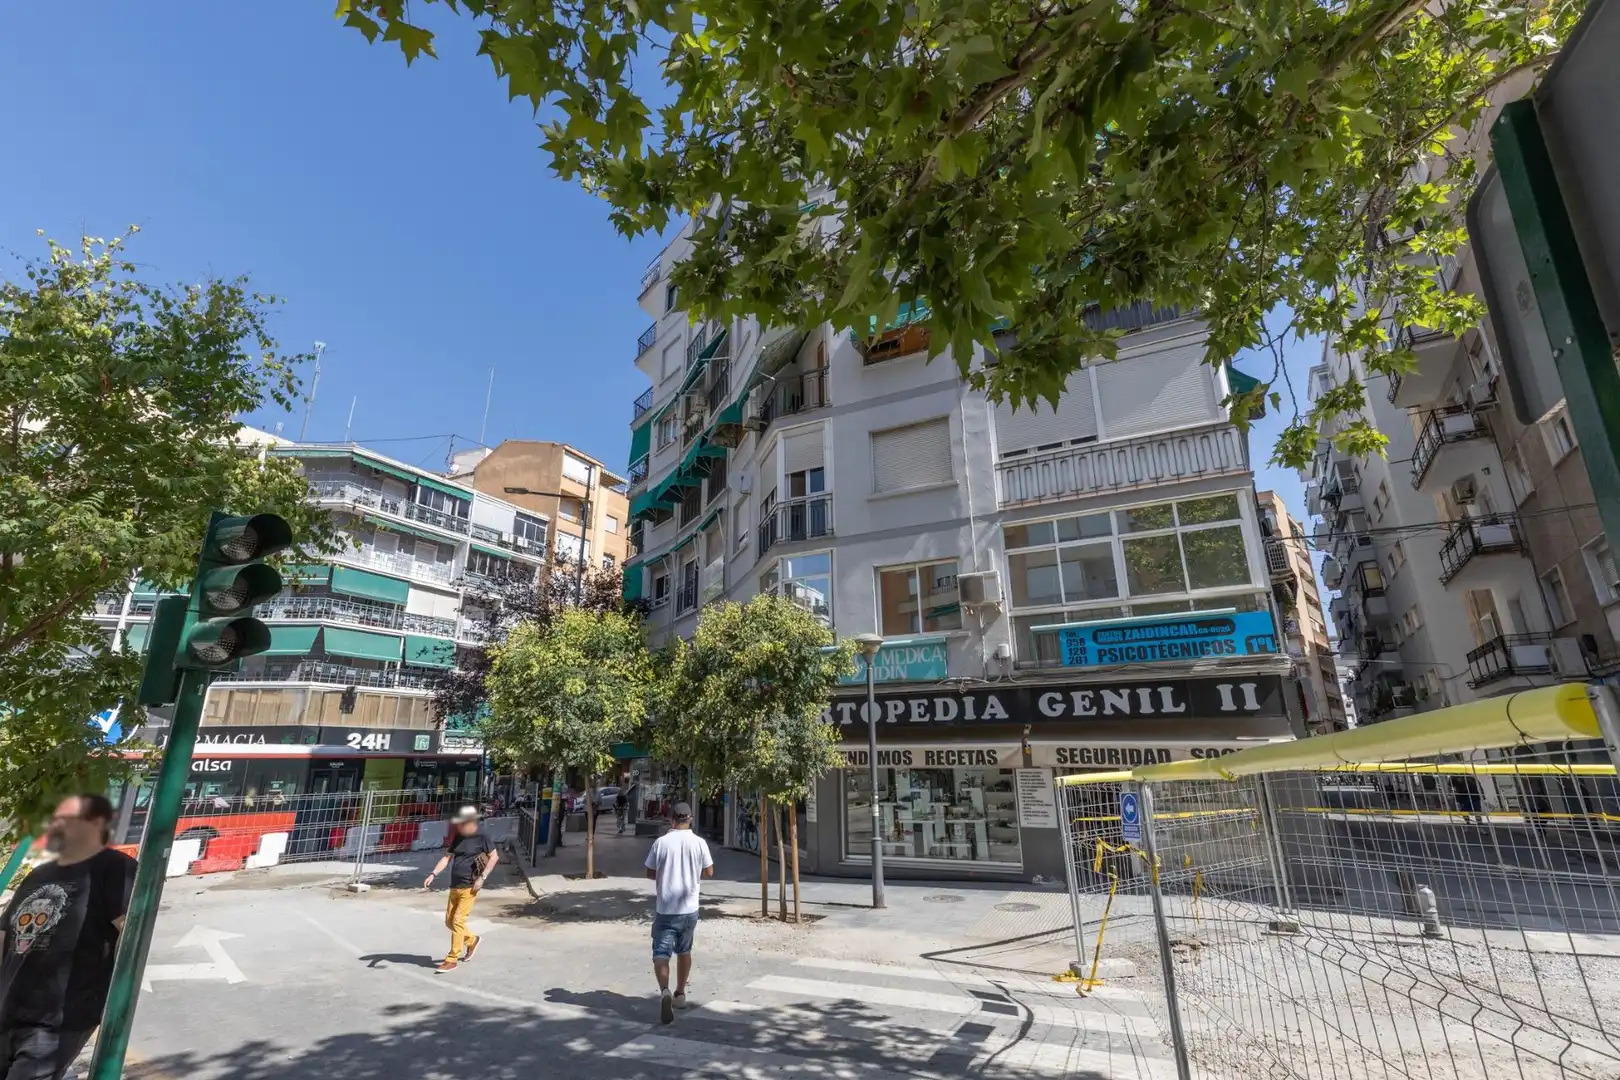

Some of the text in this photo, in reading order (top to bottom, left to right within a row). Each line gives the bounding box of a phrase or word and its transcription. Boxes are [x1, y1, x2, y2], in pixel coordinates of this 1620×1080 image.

[1098, 639, 1236, 664] PSICOTÉCNICOS
[817, 683, 1261, 725] RTOPEDIA GENIL II
[346, 732, 391, 750] 24H
[191, 758, 232, 772] alsa
[924, 748, 999, 766] RECETAS
[1055, 746, 1172, 766] SEGURIDAD
